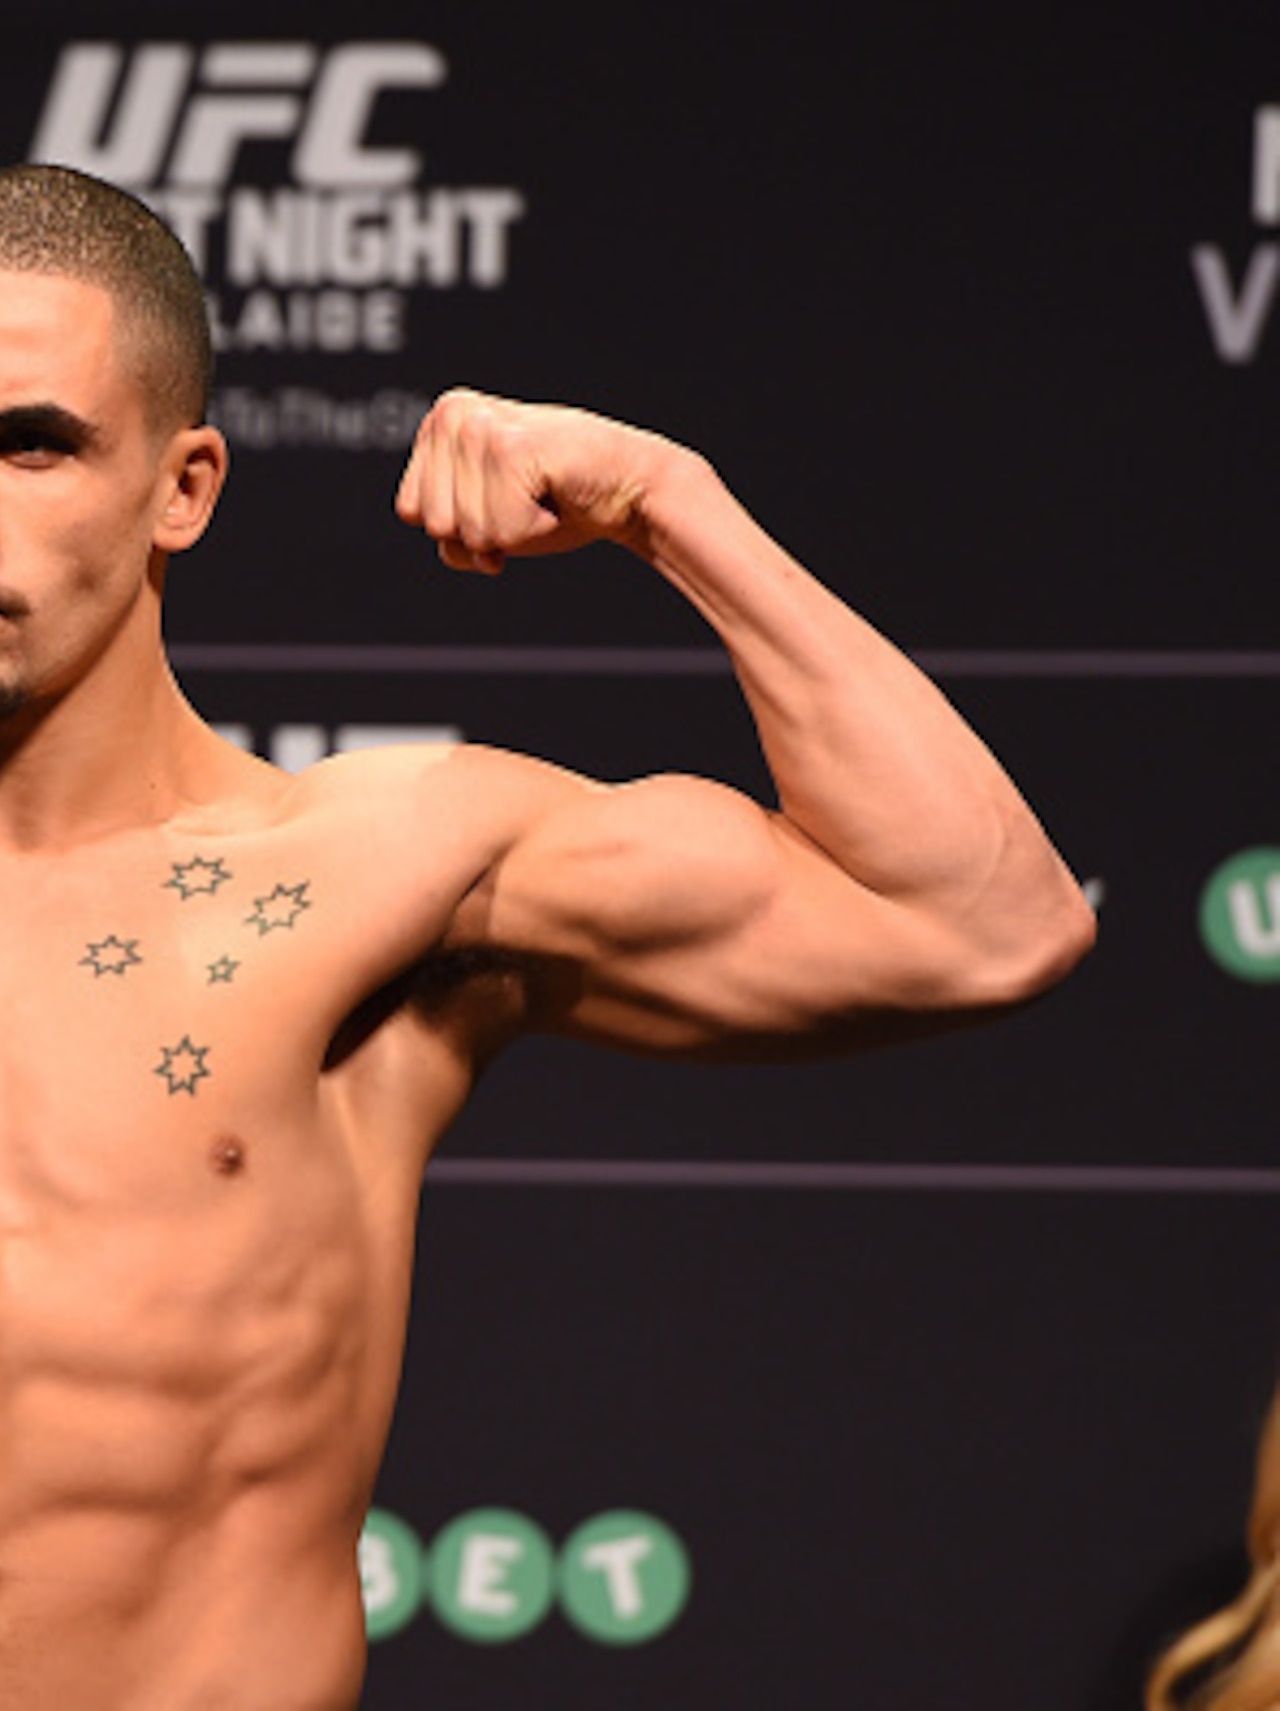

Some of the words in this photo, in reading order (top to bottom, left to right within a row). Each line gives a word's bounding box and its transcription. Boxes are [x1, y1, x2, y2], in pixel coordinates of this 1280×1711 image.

[24, 38, 449, 190] UFC
[226, 185, 525, 288] NIGHT
[208, 288, 406, 354] LAIDE
[1189, 240, 1280, 366] V
[356, 1530, 654, 1622] BET
